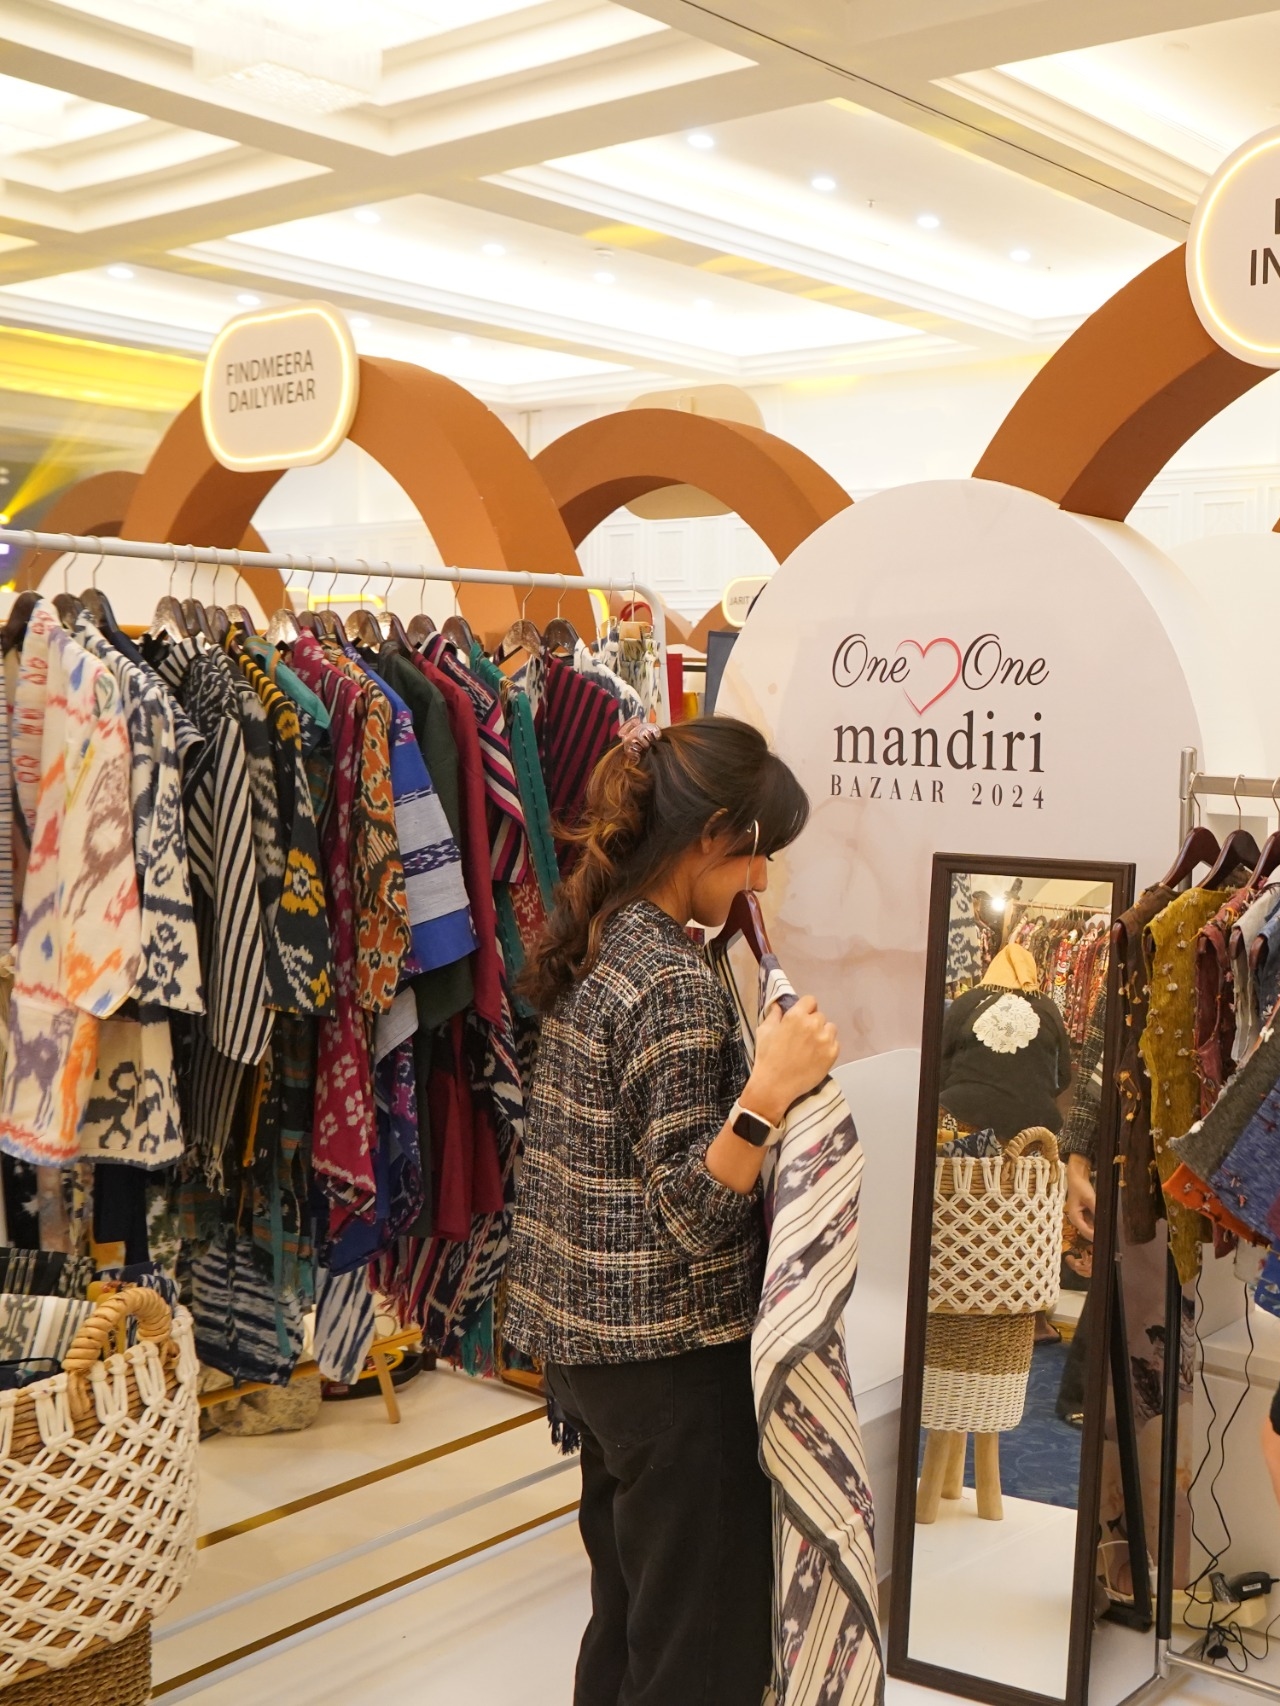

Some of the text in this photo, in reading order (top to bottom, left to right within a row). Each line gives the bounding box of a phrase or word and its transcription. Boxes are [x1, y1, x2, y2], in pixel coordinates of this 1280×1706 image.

[226, 349, 314, 386] FINDMEERA
[228, 378, 316, 414] DAILYWEAR
[832, 633, 1050, 691] One One
[833, 709, 1045, 773] mandiri
[829, 773, 1044, 810] BAZAAR 2024
